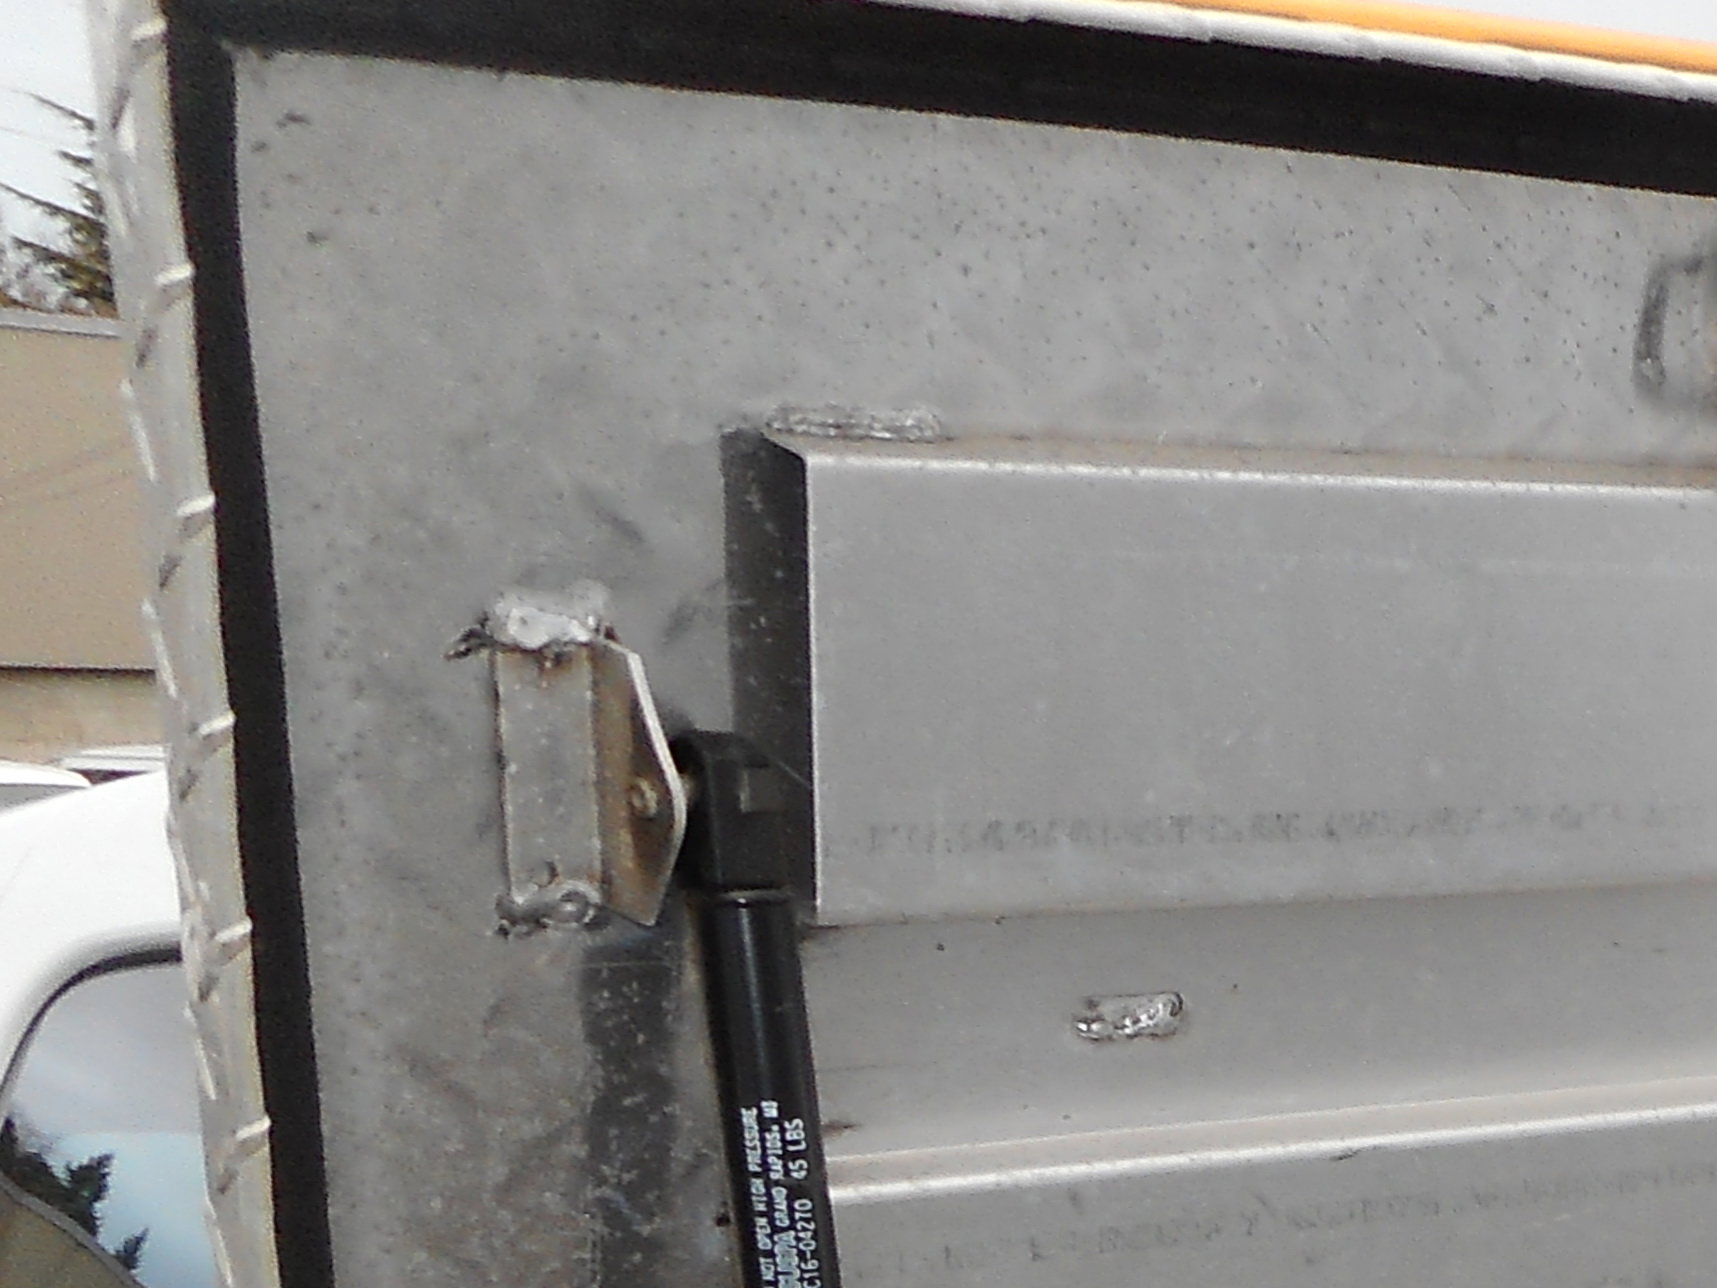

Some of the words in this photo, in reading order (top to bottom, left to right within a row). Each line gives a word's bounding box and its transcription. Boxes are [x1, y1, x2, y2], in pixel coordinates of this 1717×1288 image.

[741, 1107, 762, 1173] PRESSURE
[783, 1118, 807, 1151] LBS
[787, 1159, 808, 1180] 45
[751, 1179, 768, 1211] HIGH
[771, 1187, 790, 1227] GRAND
[754, 1217, 772, 1250] OPEN
[759, 1257, 775, 1281] NOT
